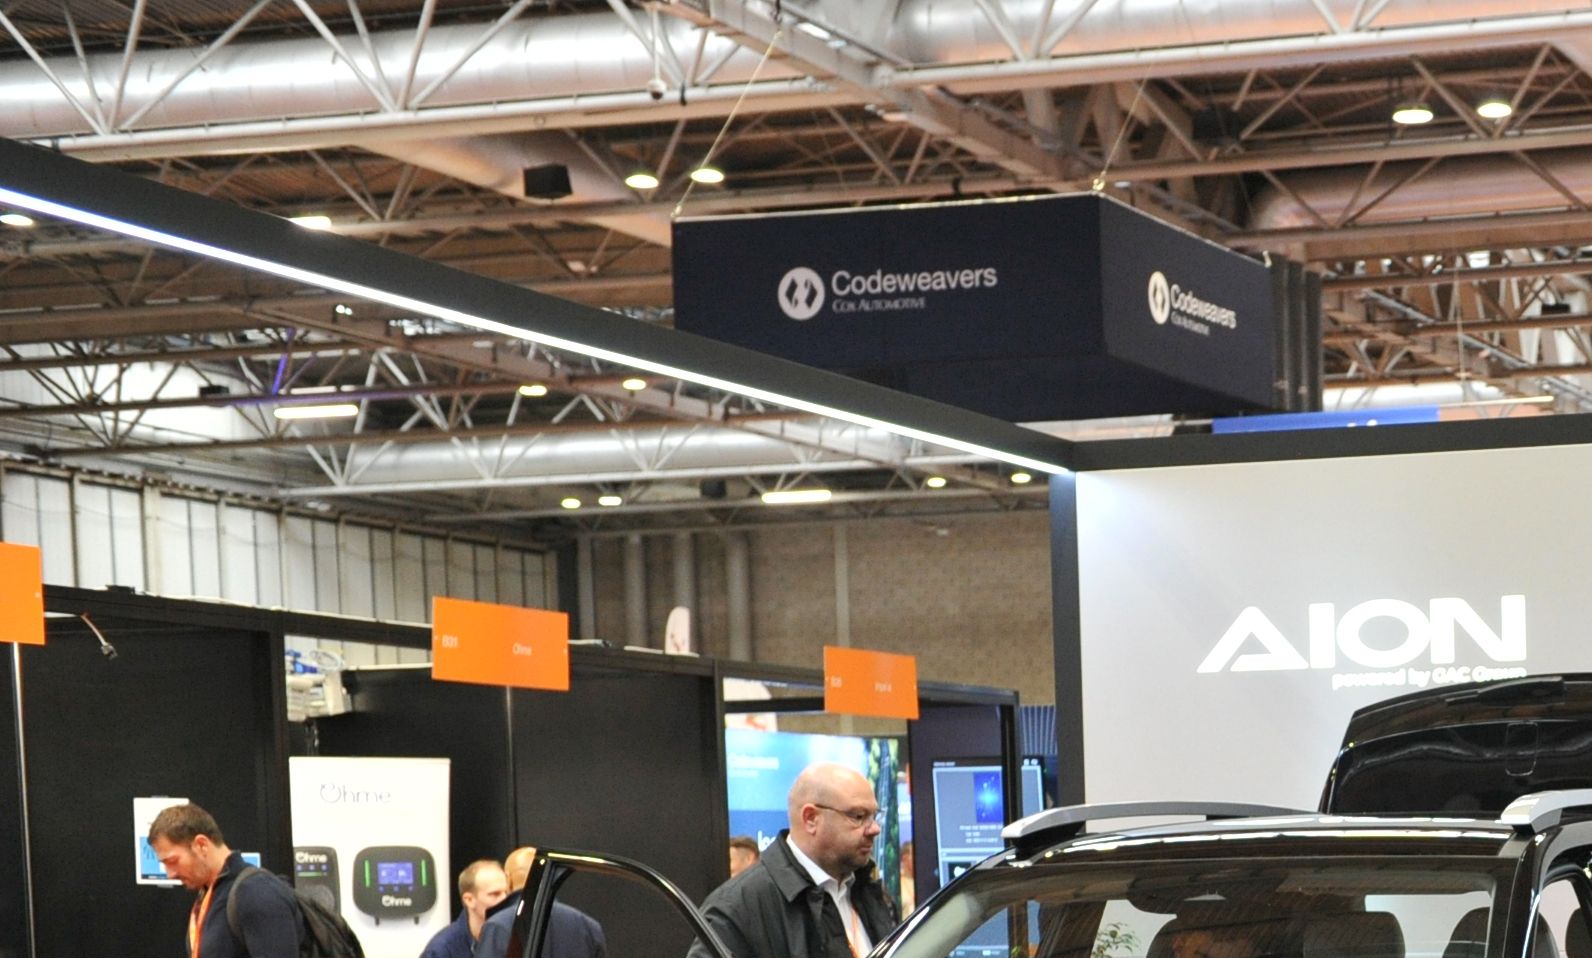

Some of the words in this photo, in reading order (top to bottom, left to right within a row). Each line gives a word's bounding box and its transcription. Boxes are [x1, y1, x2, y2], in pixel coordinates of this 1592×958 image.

[832, 267, 998, 296] Codeweavers
[1170, 284, 1236, 329] Codeweavers
[1197, 595, 1526, 673] AION
[1332, 668, 1406, 691] powered
[1408, 667, 1431, 688] by
[1432, 666, 1472, 684] GAC
[319, 783, 392, 804] Ohme
[295, 851, 328, 864] Ohme
[381, 895, 412, 908] Ohme
